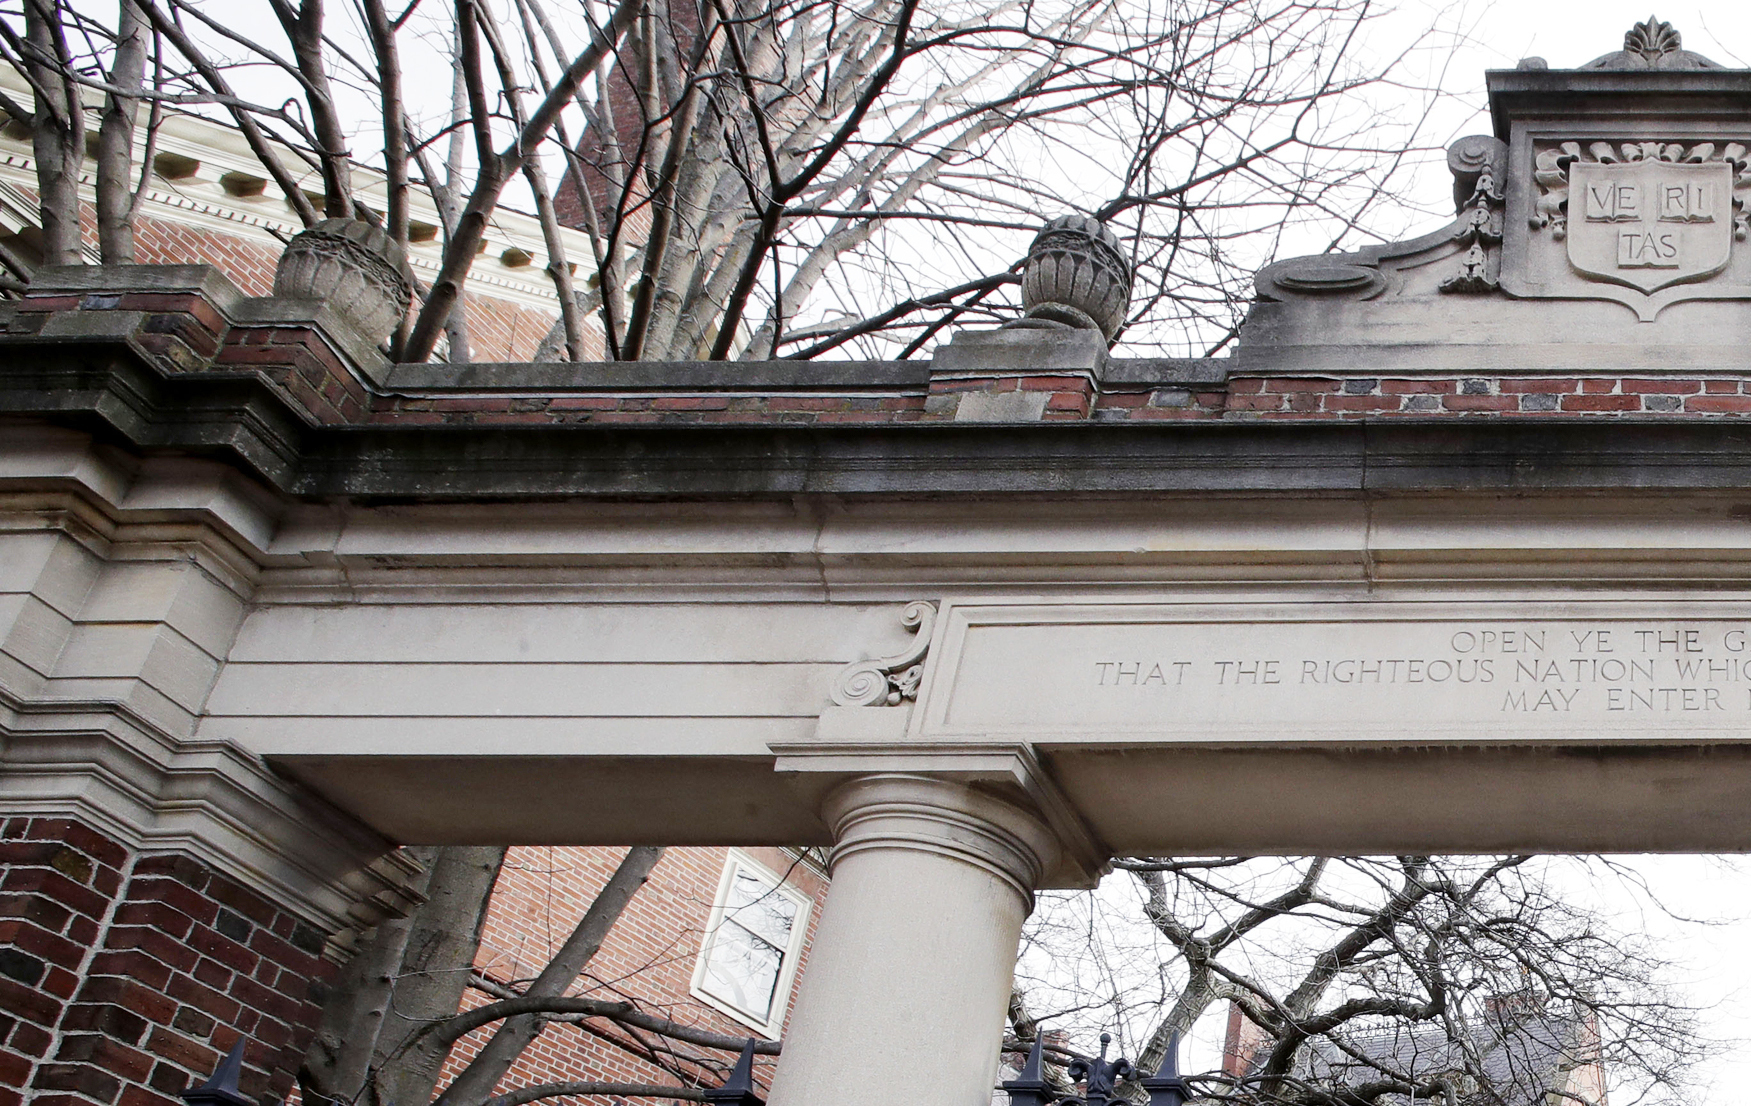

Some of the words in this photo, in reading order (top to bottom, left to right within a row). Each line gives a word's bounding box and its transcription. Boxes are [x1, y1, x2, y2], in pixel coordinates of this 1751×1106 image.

[1621, 232, 1677, 259] TAS
[1451, 630, 1546, 654] OPEN
[1570, 630, 1613, 653] YE
[1635, 630, 1704, 653] THE
[1095, 661, 1192, 686] THAT
[1215, 660, 1281, 685] THE
[1300, 658, 1494, 685] RIGHTEOUS
[1514, 658, 1654, 683] NATION
[1500, 688, 1581, 713] MAY
[1606, 688, 1726, 712] ENTER
